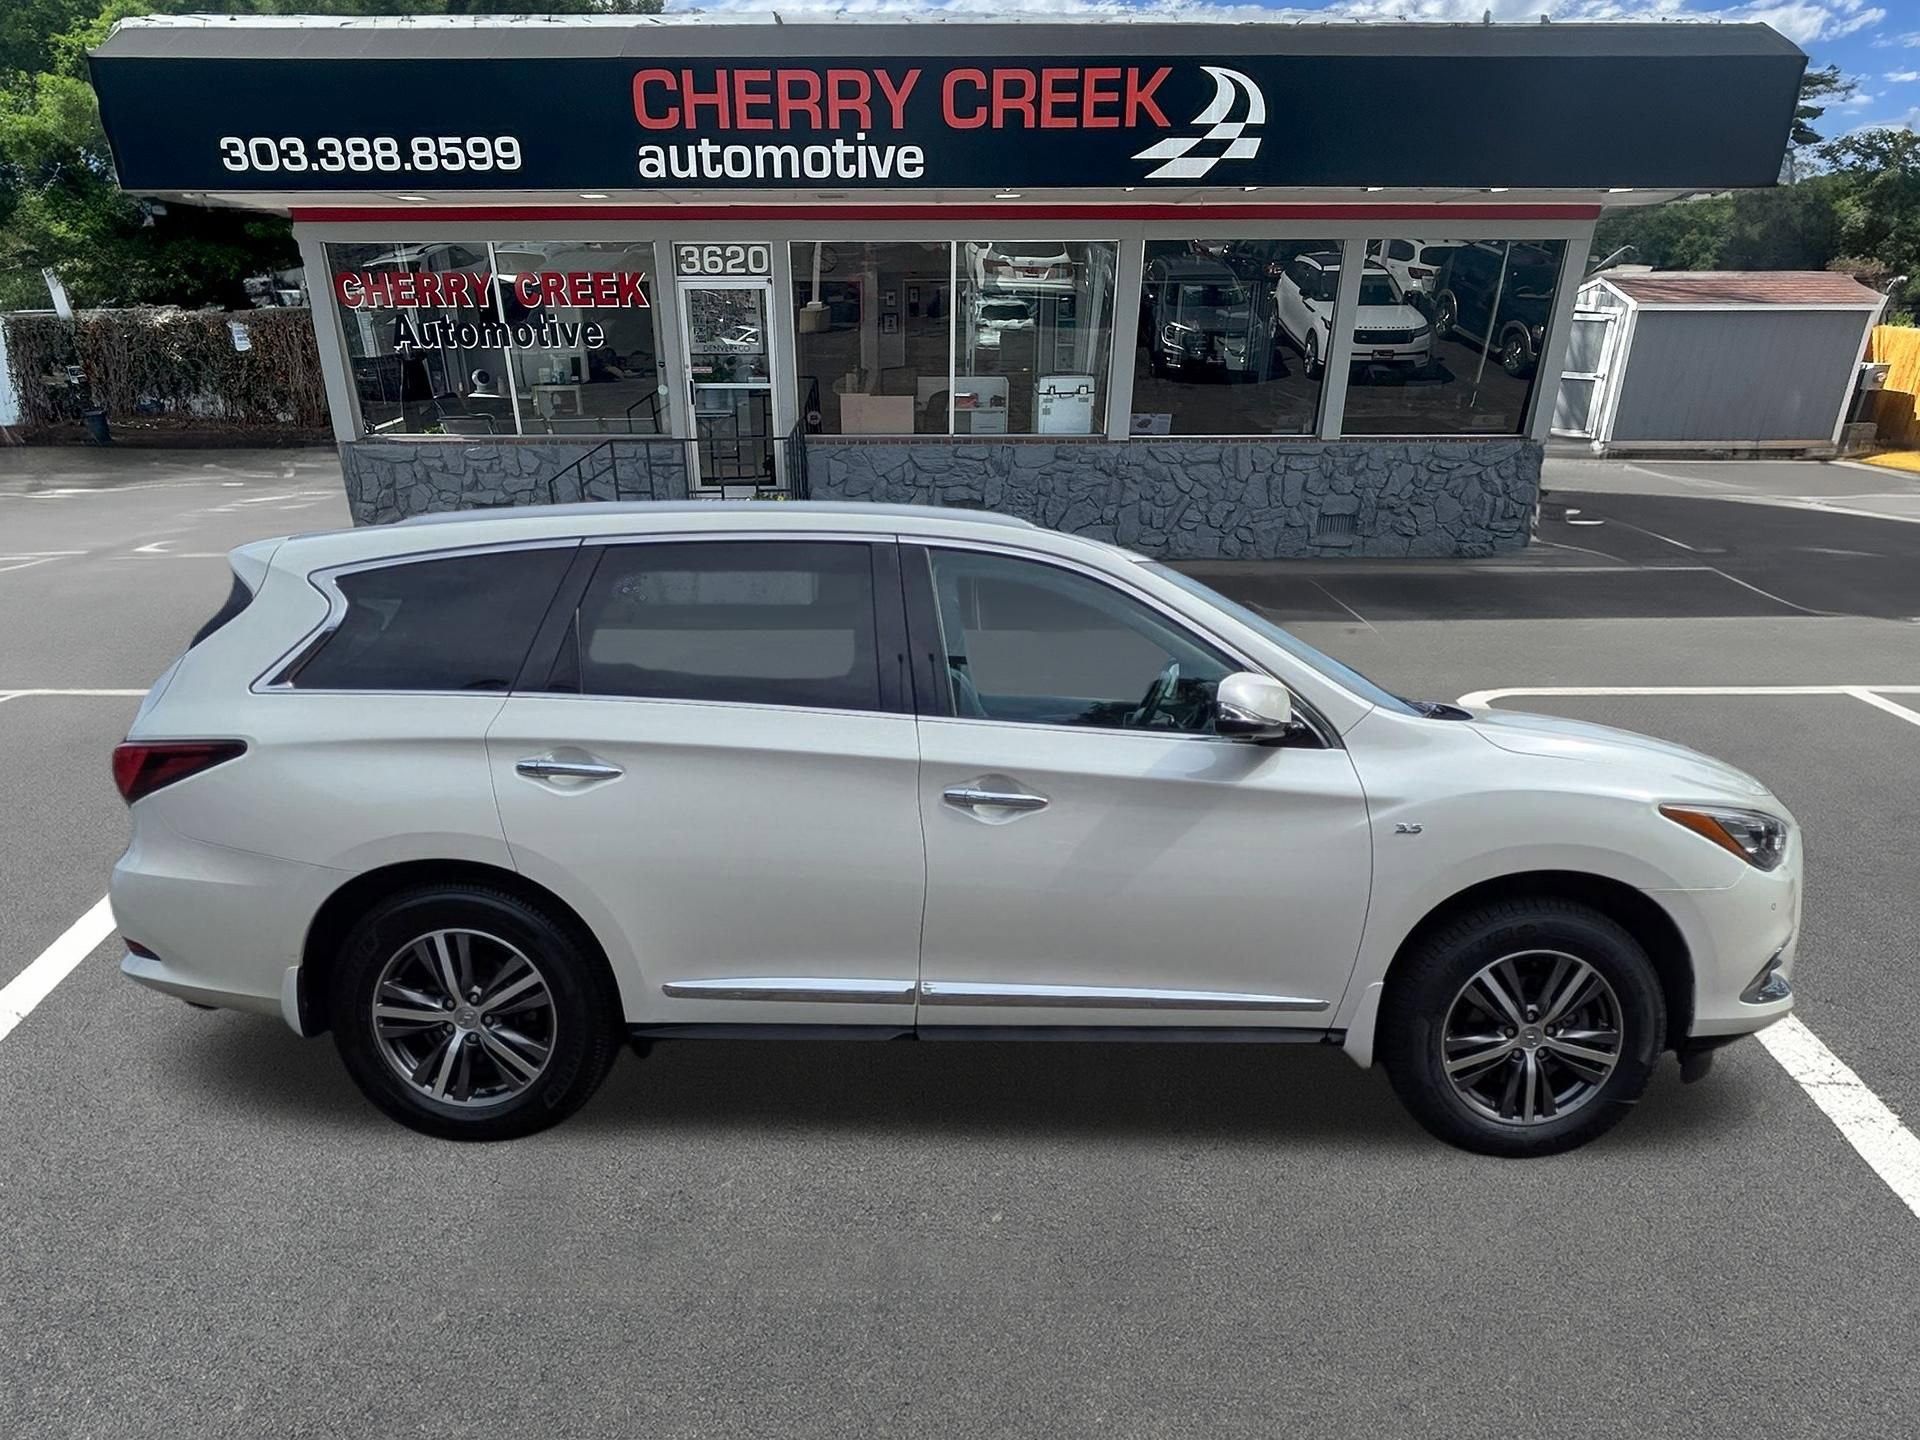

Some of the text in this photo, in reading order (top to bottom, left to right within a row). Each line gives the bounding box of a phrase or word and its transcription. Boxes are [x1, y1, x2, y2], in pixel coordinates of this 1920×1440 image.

[632, 66, 1172, 131] CHERRY CREEK
[220, 135, 523, 173] 303.388.8599
[638, 132, 925, 180] automotive
[680, 245, 769, 274] 3620
[335, 271, 651, 308] CHERRY CREEK
[394, 314, 606, 350] Automotive
